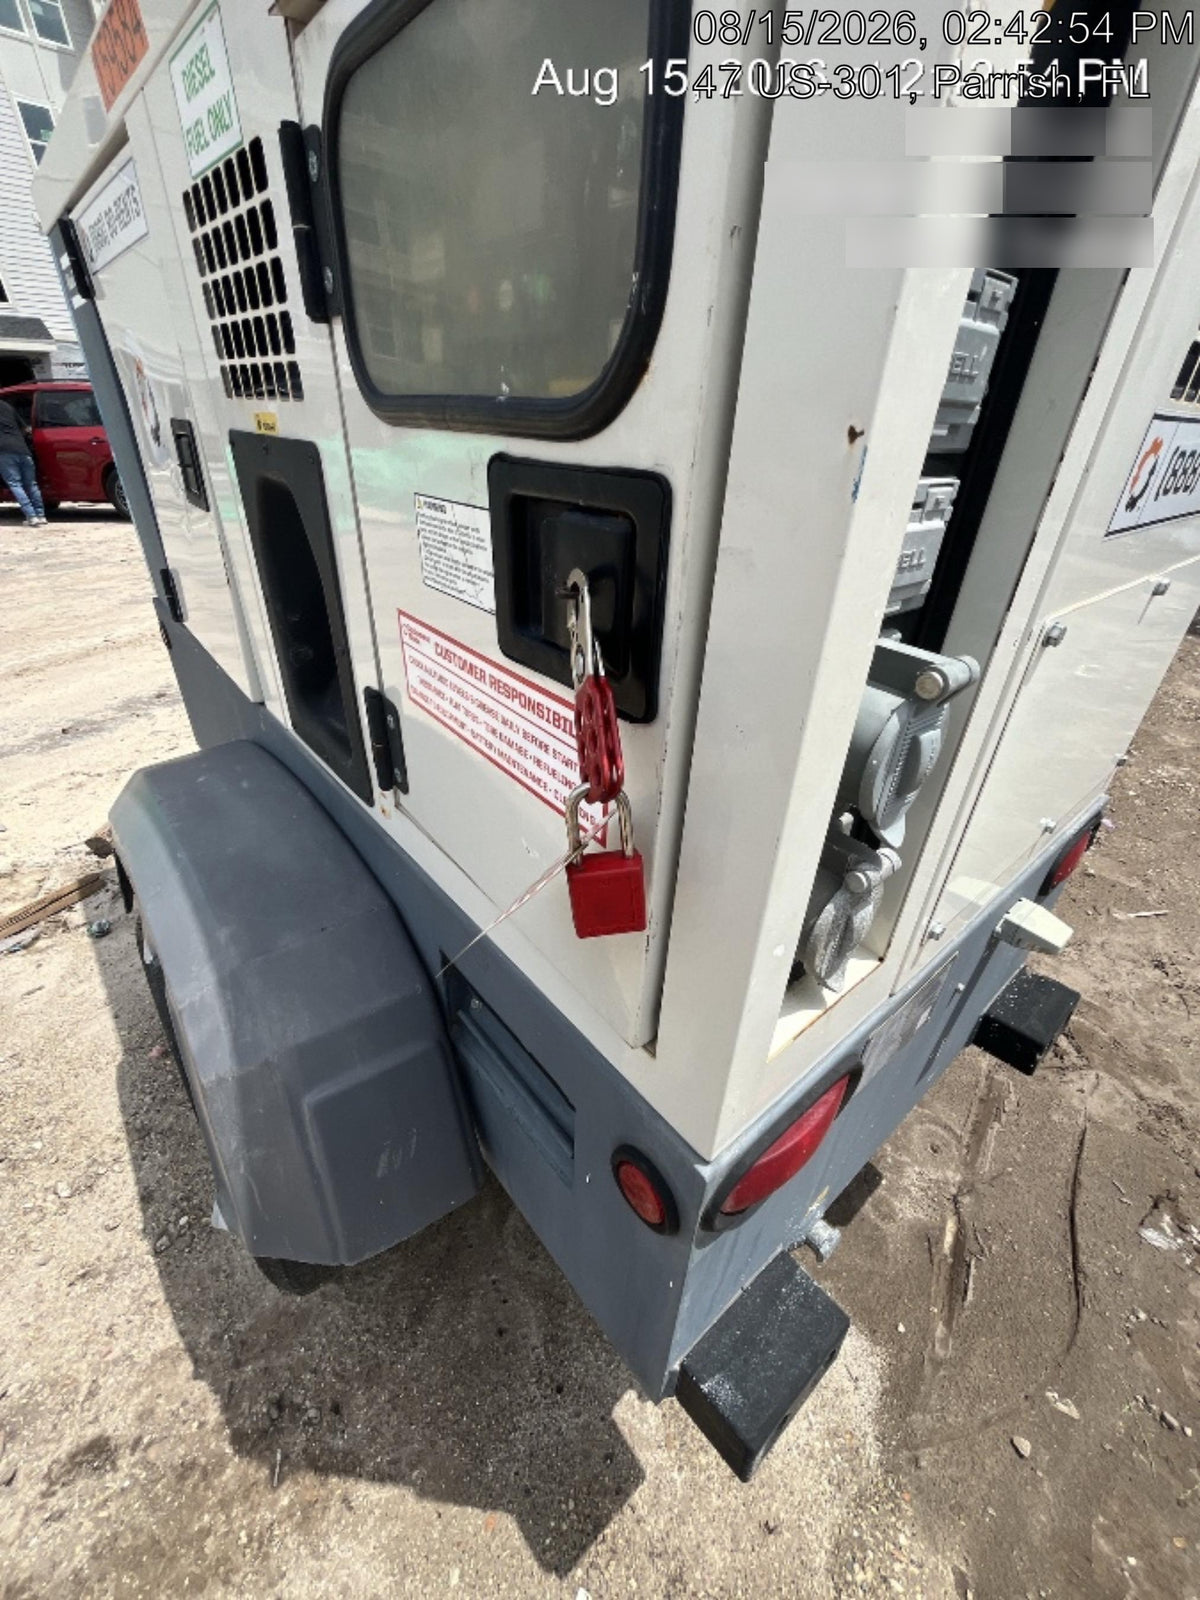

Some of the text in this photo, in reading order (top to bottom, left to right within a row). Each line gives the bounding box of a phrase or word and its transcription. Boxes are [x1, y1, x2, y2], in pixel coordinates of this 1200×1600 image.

[181, 41, 215, 103] DIESEL
[185, 89, 235, 160] FUEL ONLY
[433, 639, 486, 686] CUSTOMER
[488, 671, 576, 741] RESPONSIBIL
